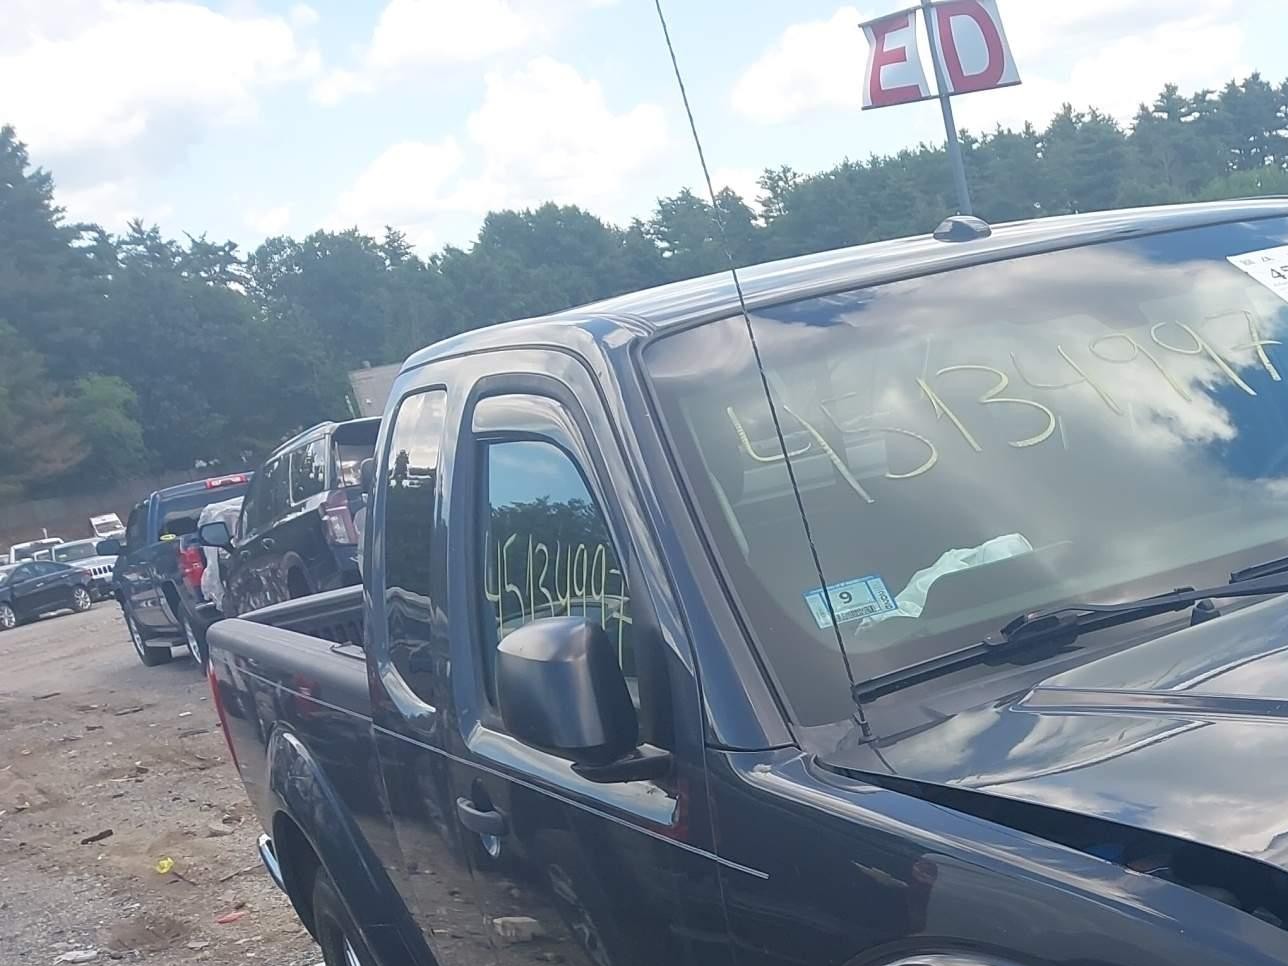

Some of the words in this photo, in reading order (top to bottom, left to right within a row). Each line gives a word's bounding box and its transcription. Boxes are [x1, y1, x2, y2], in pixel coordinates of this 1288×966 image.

[726, 310, 1283, 503] 45134997
[484, 530, 633, 671] 45134997
[837, 590, 853, 605] 9
